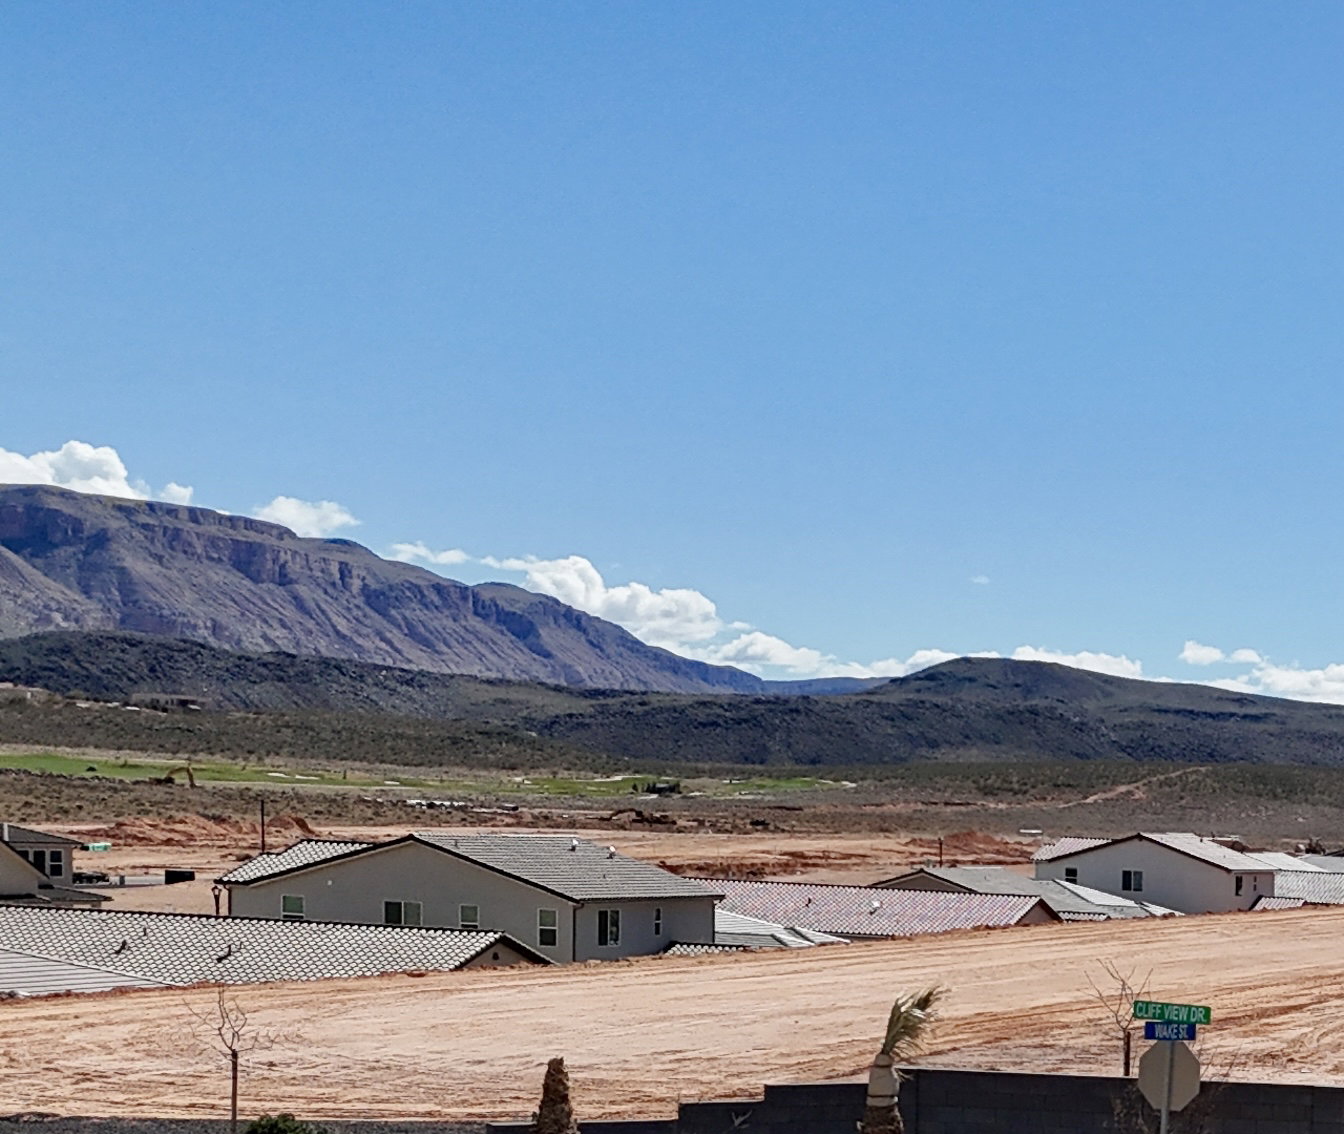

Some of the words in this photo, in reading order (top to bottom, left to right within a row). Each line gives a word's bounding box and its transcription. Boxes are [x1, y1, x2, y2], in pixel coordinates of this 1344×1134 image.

[1136, 1002, 1162, 1018] CLIFF
[1164, 1005, 1189, 1021] VIEW
[1155, 1024, 1178, 1039] WAKE
